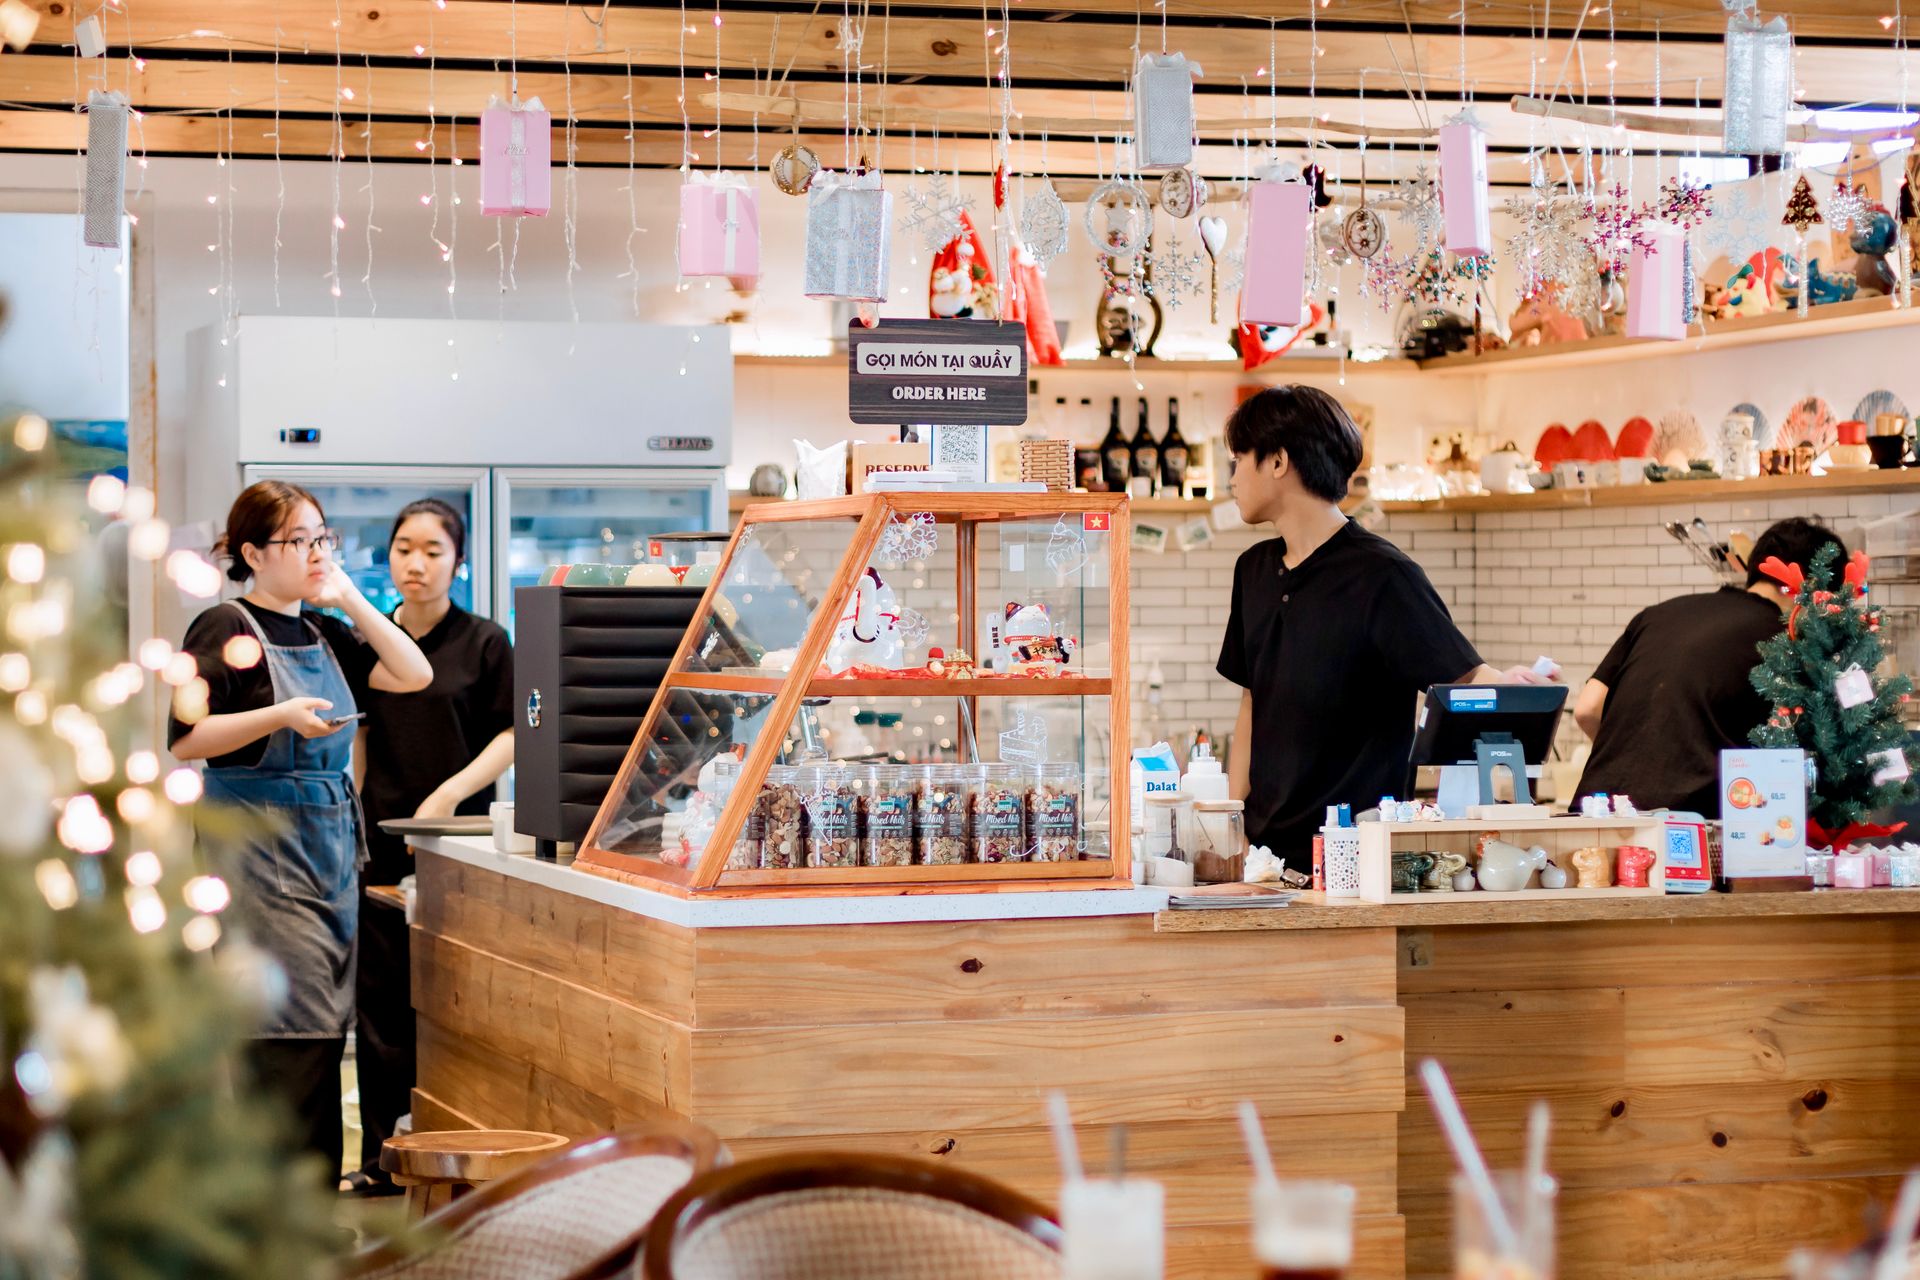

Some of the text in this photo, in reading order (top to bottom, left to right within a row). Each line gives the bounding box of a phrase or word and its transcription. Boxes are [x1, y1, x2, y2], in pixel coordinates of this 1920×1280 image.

[865, 349, 1012, 372] GỌI MÓN TẠI QUẦY
[892, 386, 987, 401] ORDER HERE
[1146, 782, 1177, 792] Dalat
[867, 814, 906, 825] Mixed Nuts
[985, 814, 1008, 824] Mixed
[1038, 813, 1061, 824] Mixed
